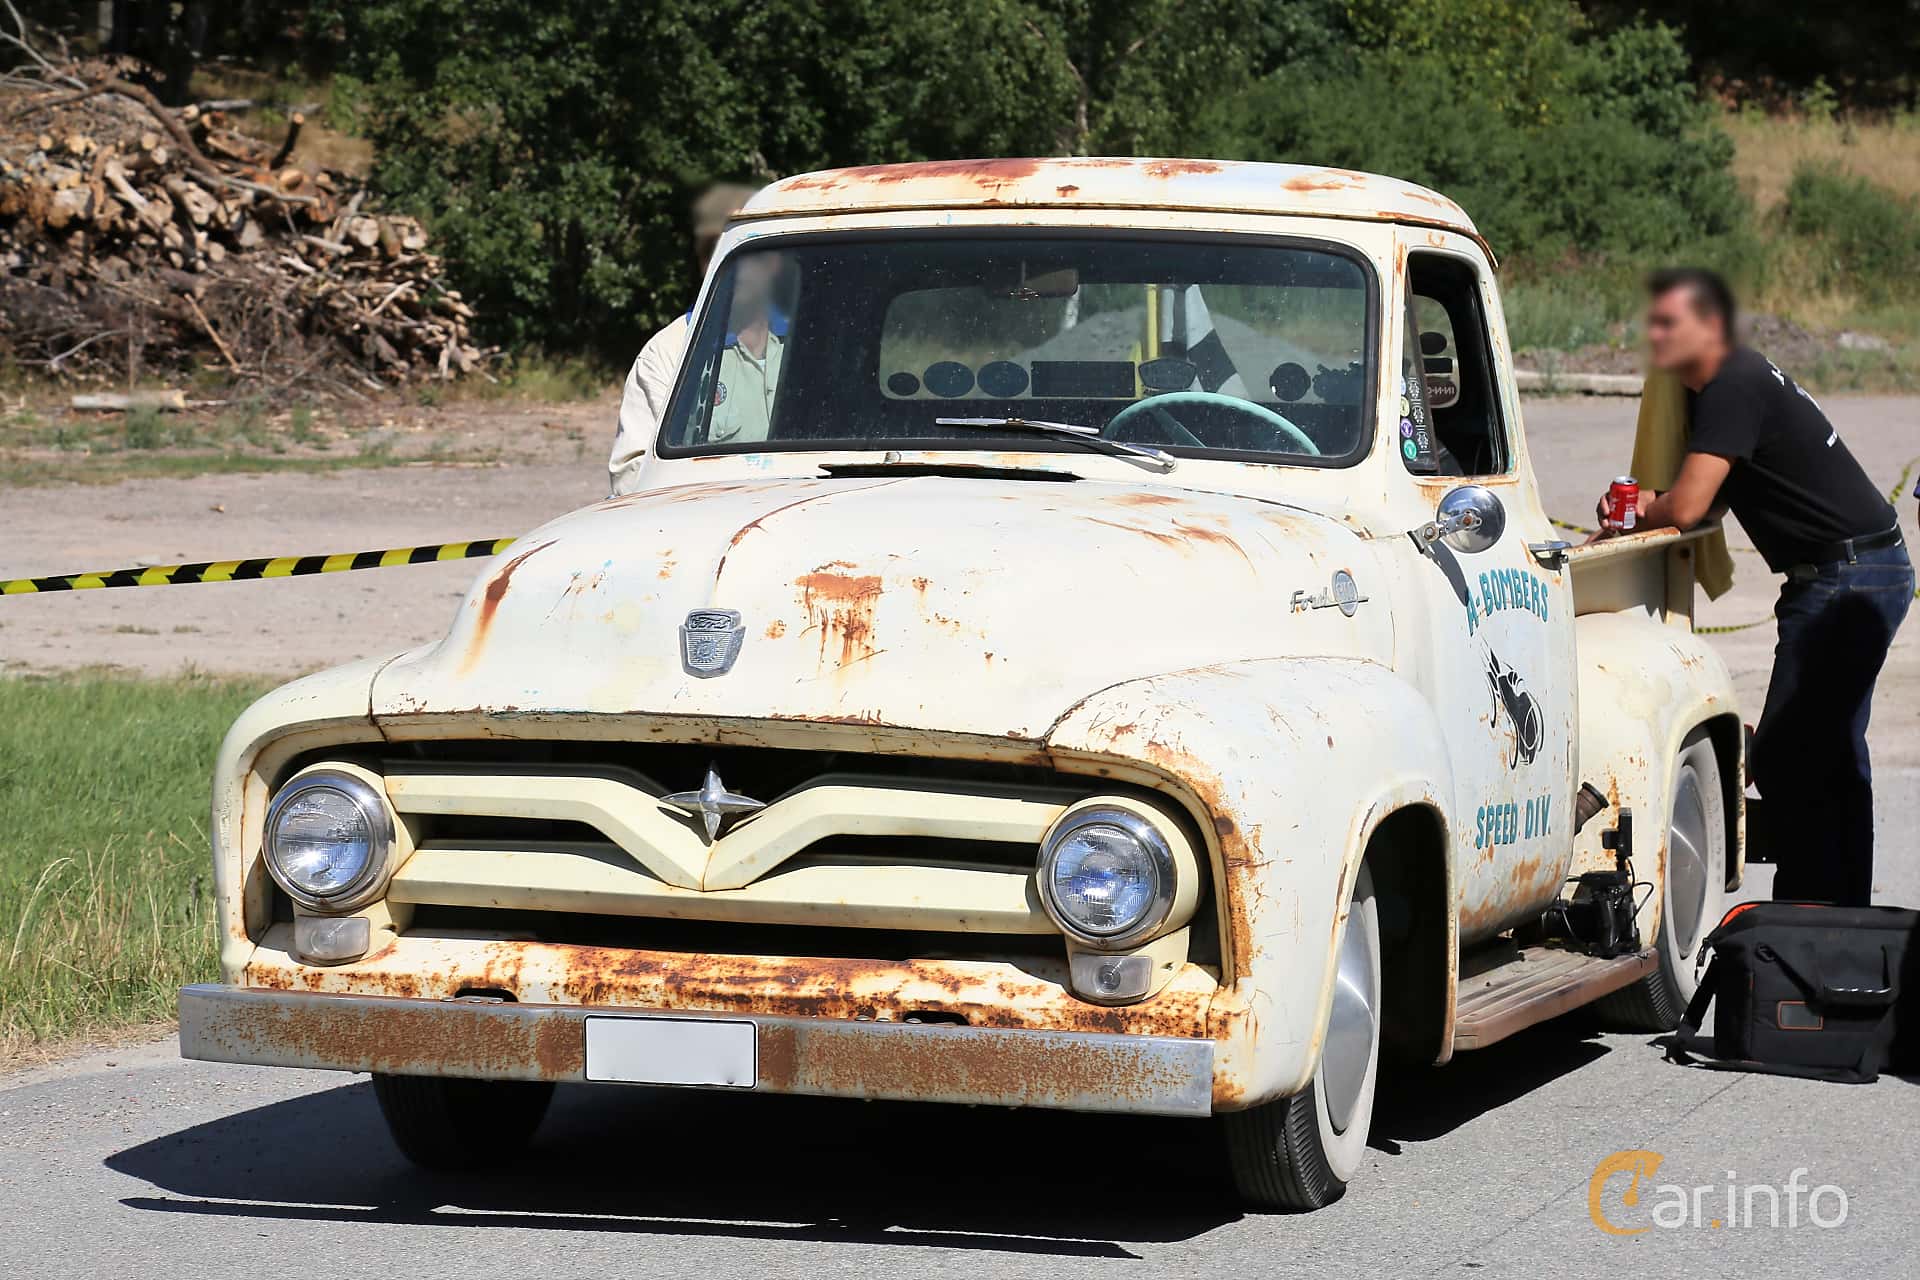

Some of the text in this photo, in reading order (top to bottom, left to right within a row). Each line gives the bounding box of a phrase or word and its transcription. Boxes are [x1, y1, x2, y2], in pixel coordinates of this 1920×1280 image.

[1290, 587, 1328, 612] Ford
[1465, 568, 1548, 637] A-BOMBERS
[690, 614, 732, 629] Ford
[1476, 803, 1518, 850] SPEED
